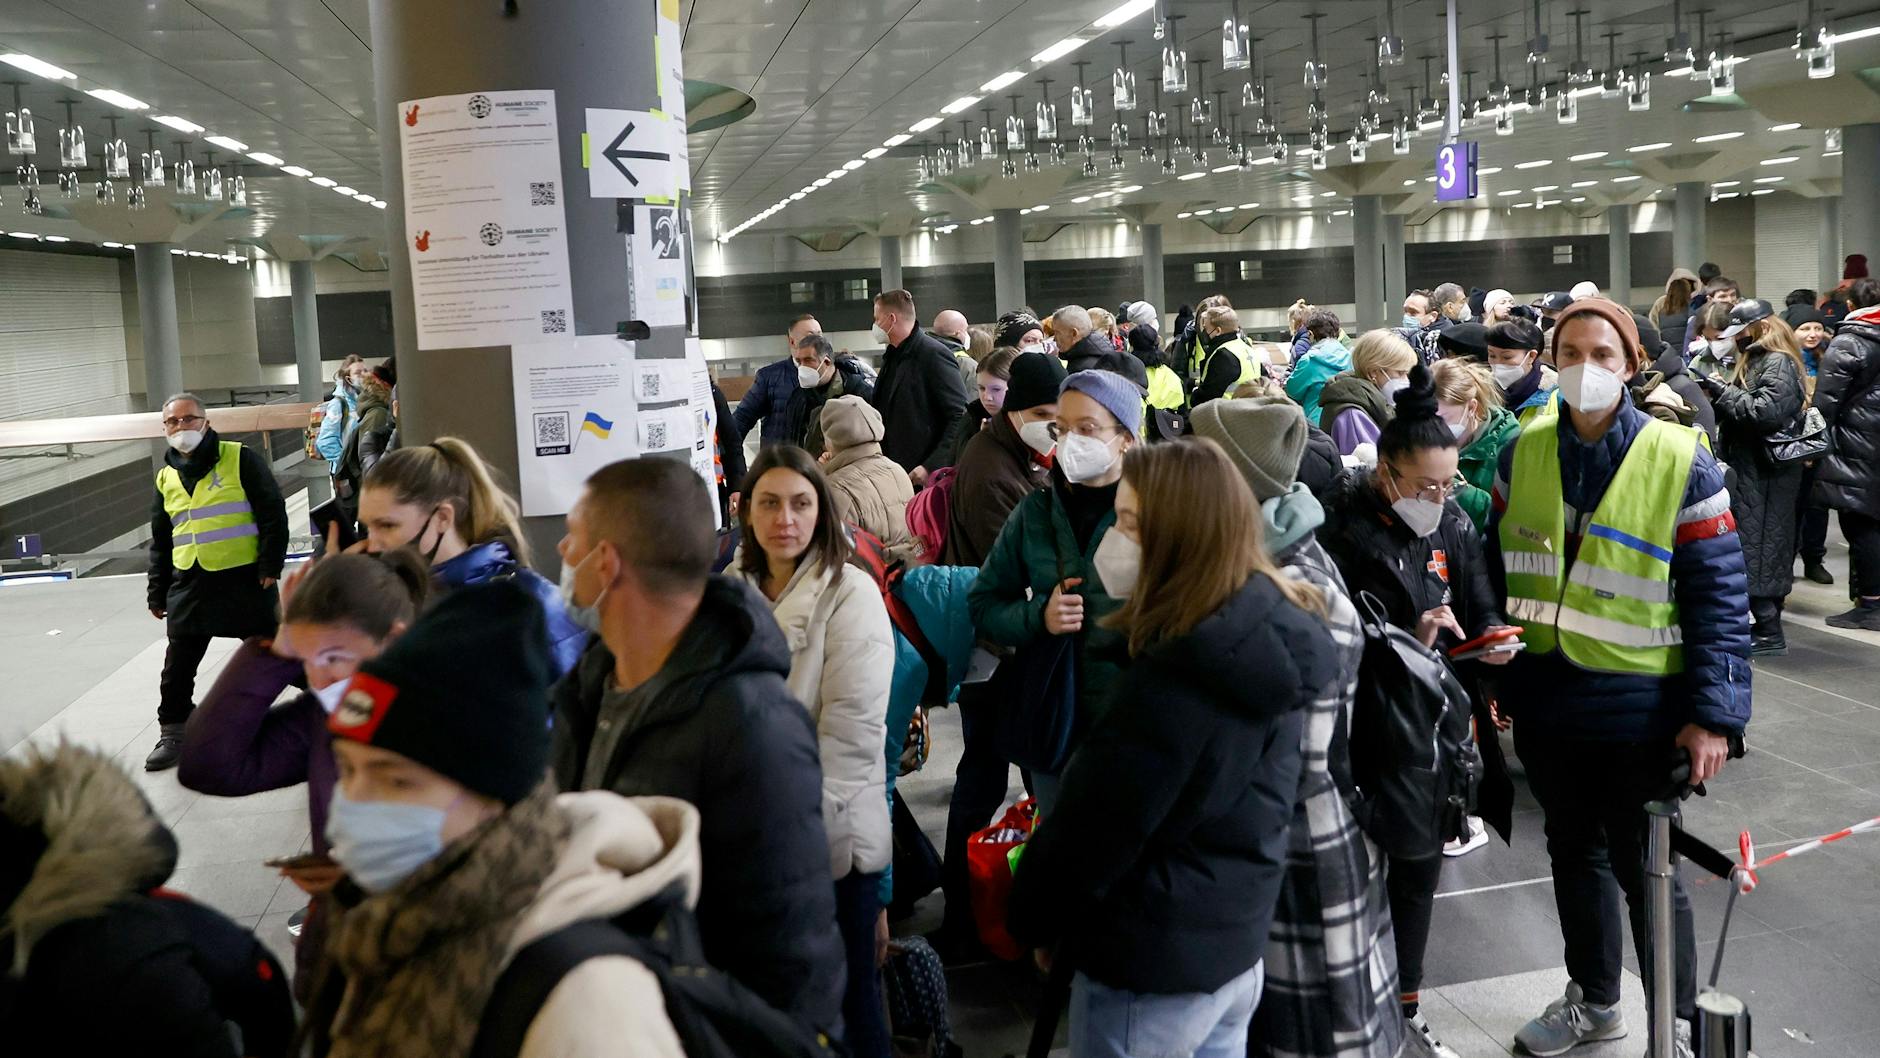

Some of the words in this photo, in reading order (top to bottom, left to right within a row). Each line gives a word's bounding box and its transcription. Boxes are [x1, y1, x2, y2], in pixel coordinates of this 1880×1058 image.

[1439, 147, 1456, 189] 3
[540, 447, 556, 455] SCAN
[557, 446, 567, 454] ME
[18, 536, 27, 553] 1
